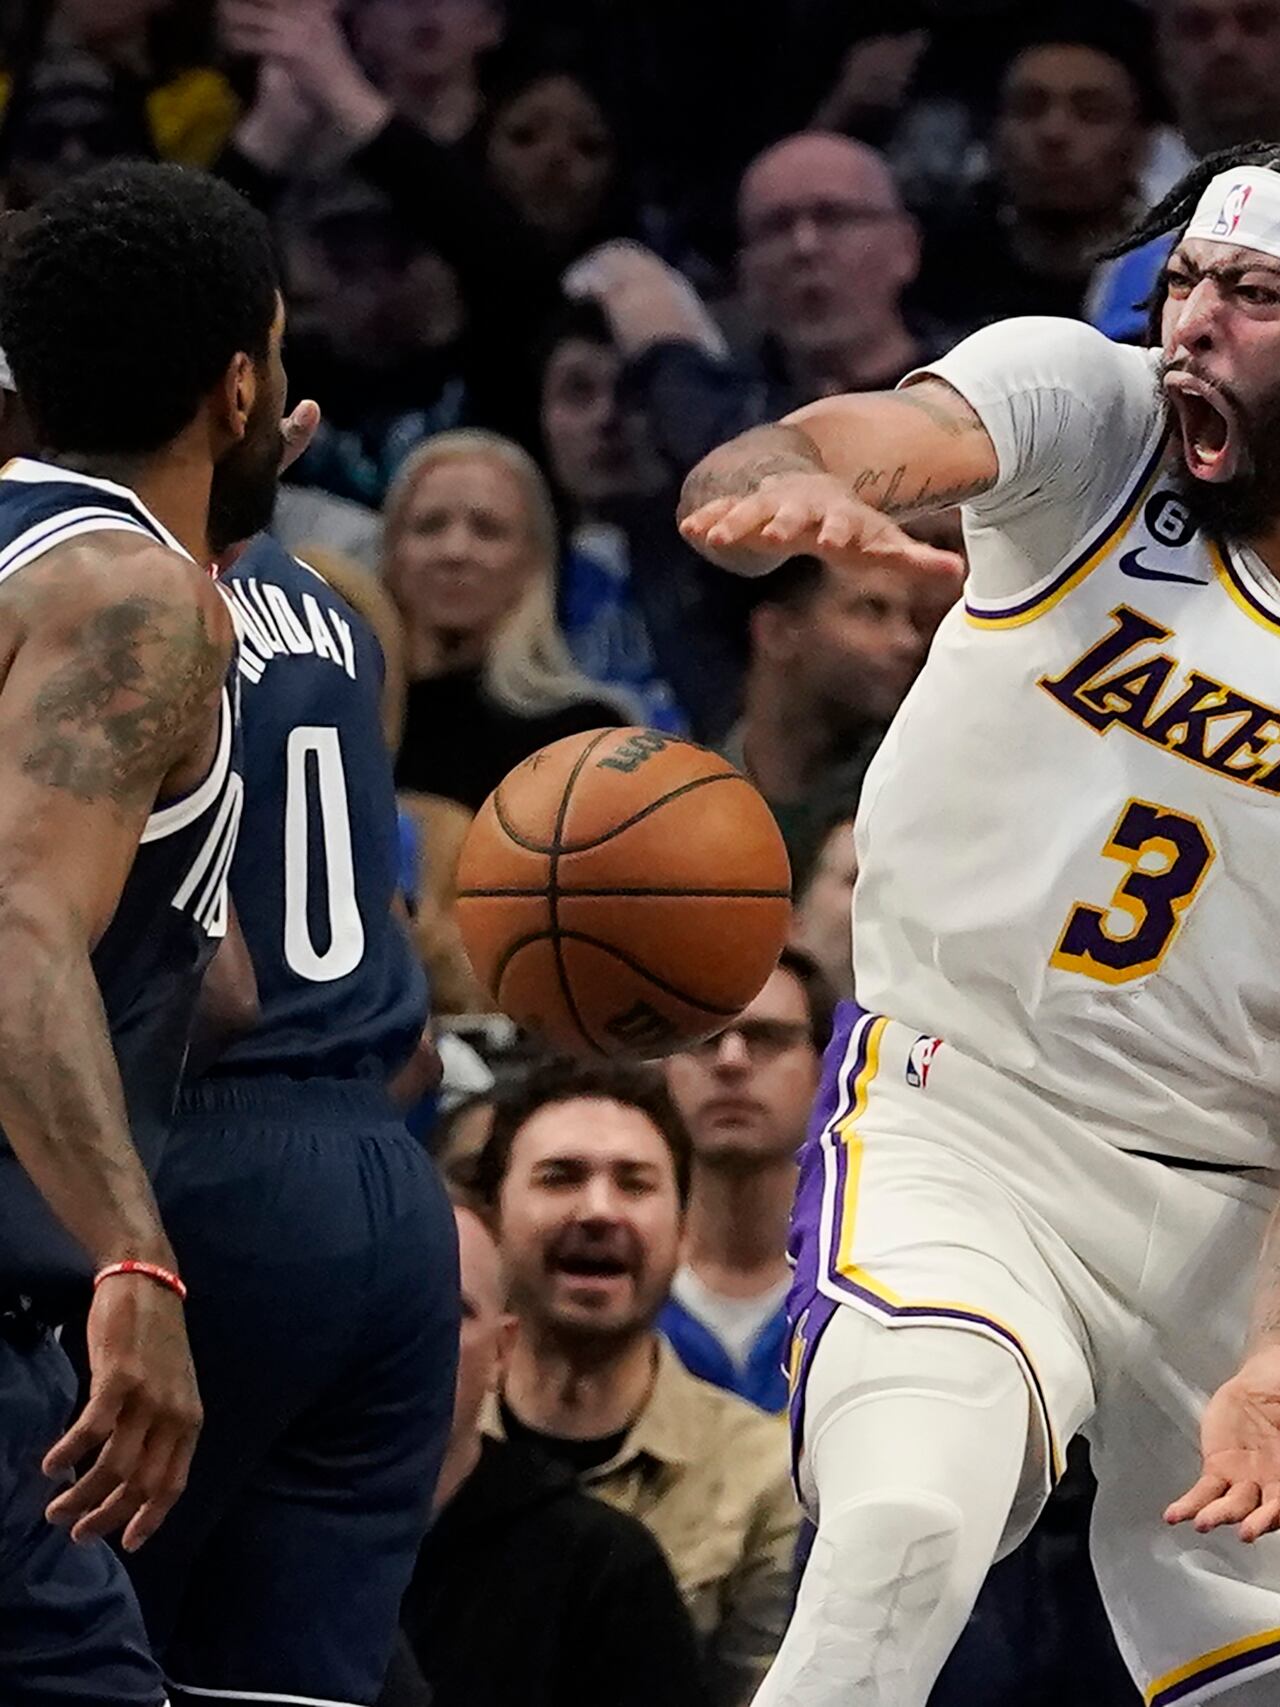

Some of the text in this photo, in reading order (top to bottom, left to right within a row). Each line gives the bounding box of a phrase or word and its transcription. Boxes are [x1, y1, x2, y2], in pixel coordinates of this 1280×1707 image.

[1154, 500, 1190, 541] 6
[284, 726, 365, 982] 0
[1048, 796, 1217, 986] 3
